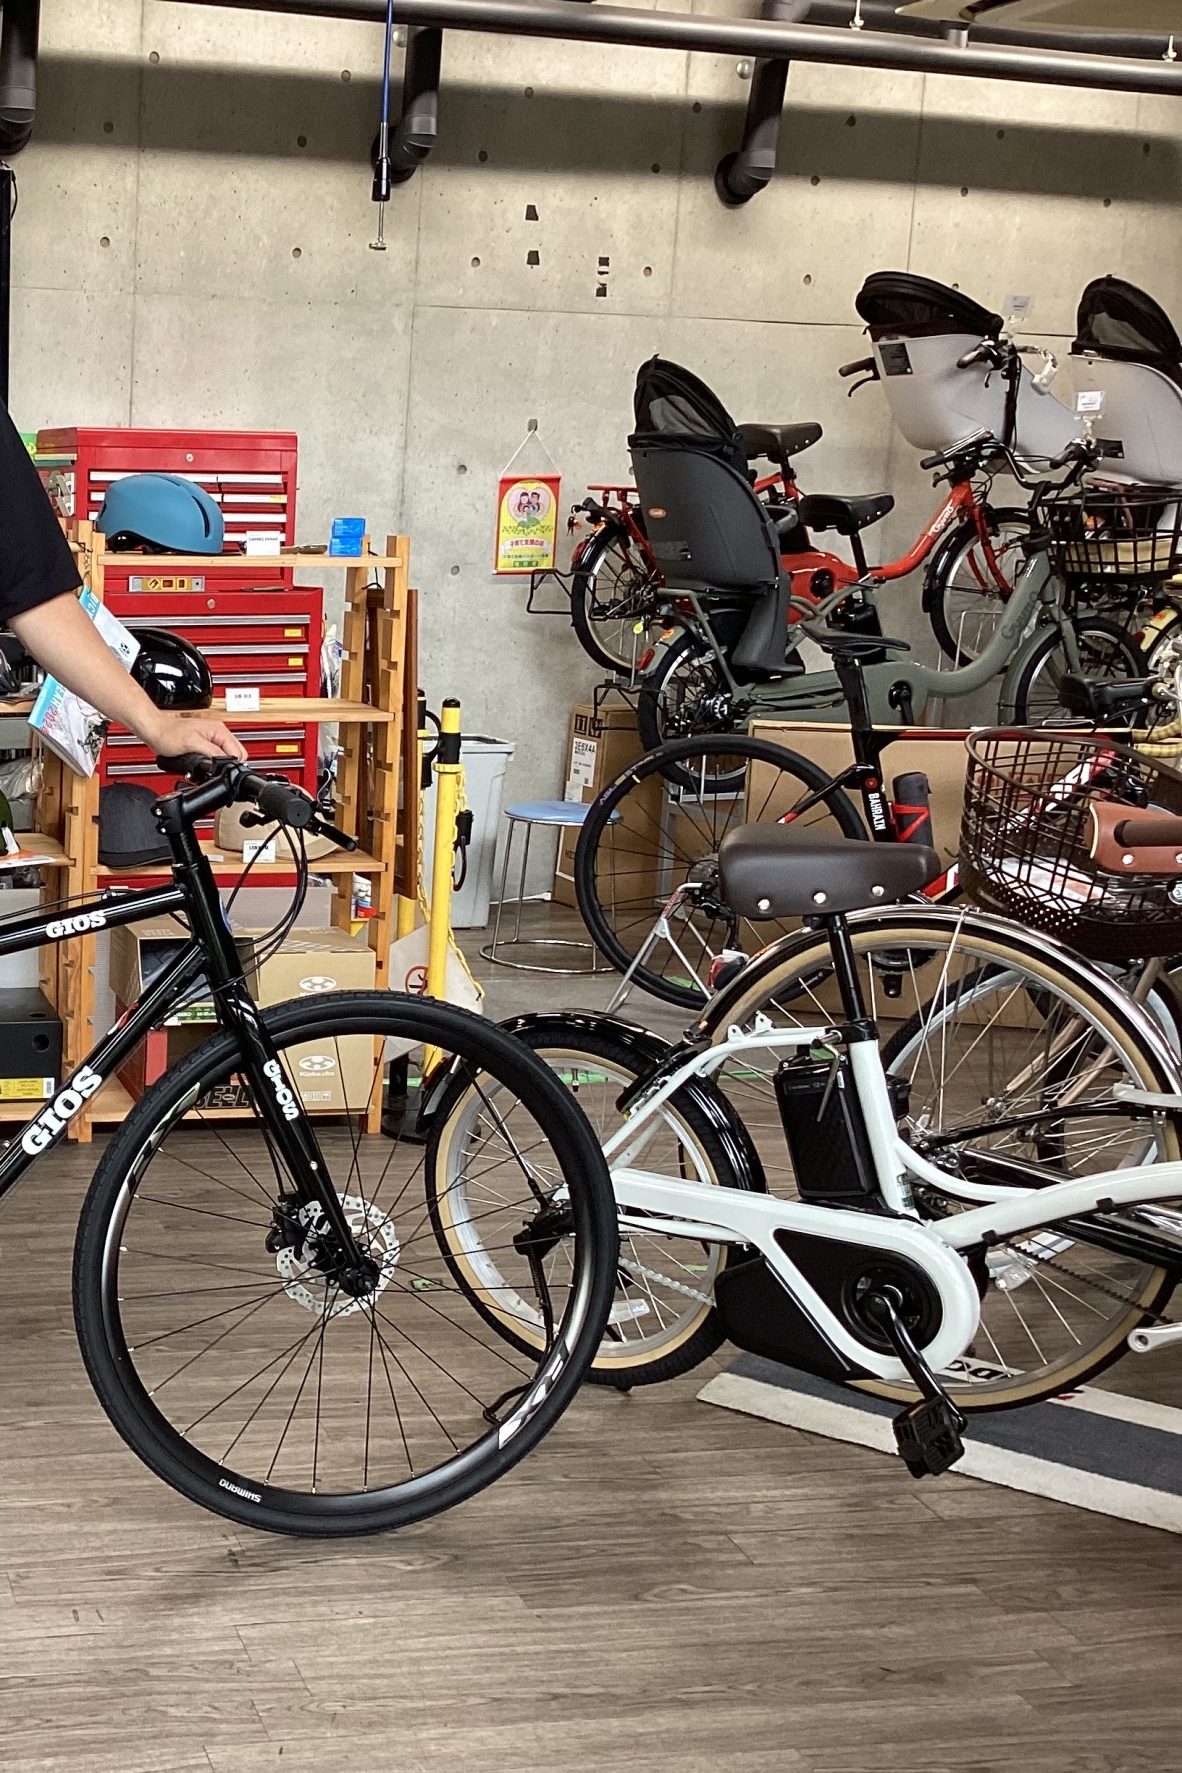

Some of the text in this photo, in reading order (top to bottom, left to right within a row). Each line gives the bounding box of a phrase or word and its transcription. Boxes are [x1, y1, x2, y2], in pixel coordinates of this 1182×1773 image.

[868, 793, 886, 830] BAHRAIN
[45, 910, 106, 938] GIOS
[263, 1059, 300, 1121] GIOS
[22, 1065, 102, 1155] GIOS
[218, 1478, 262, 1503] SHIMANO
